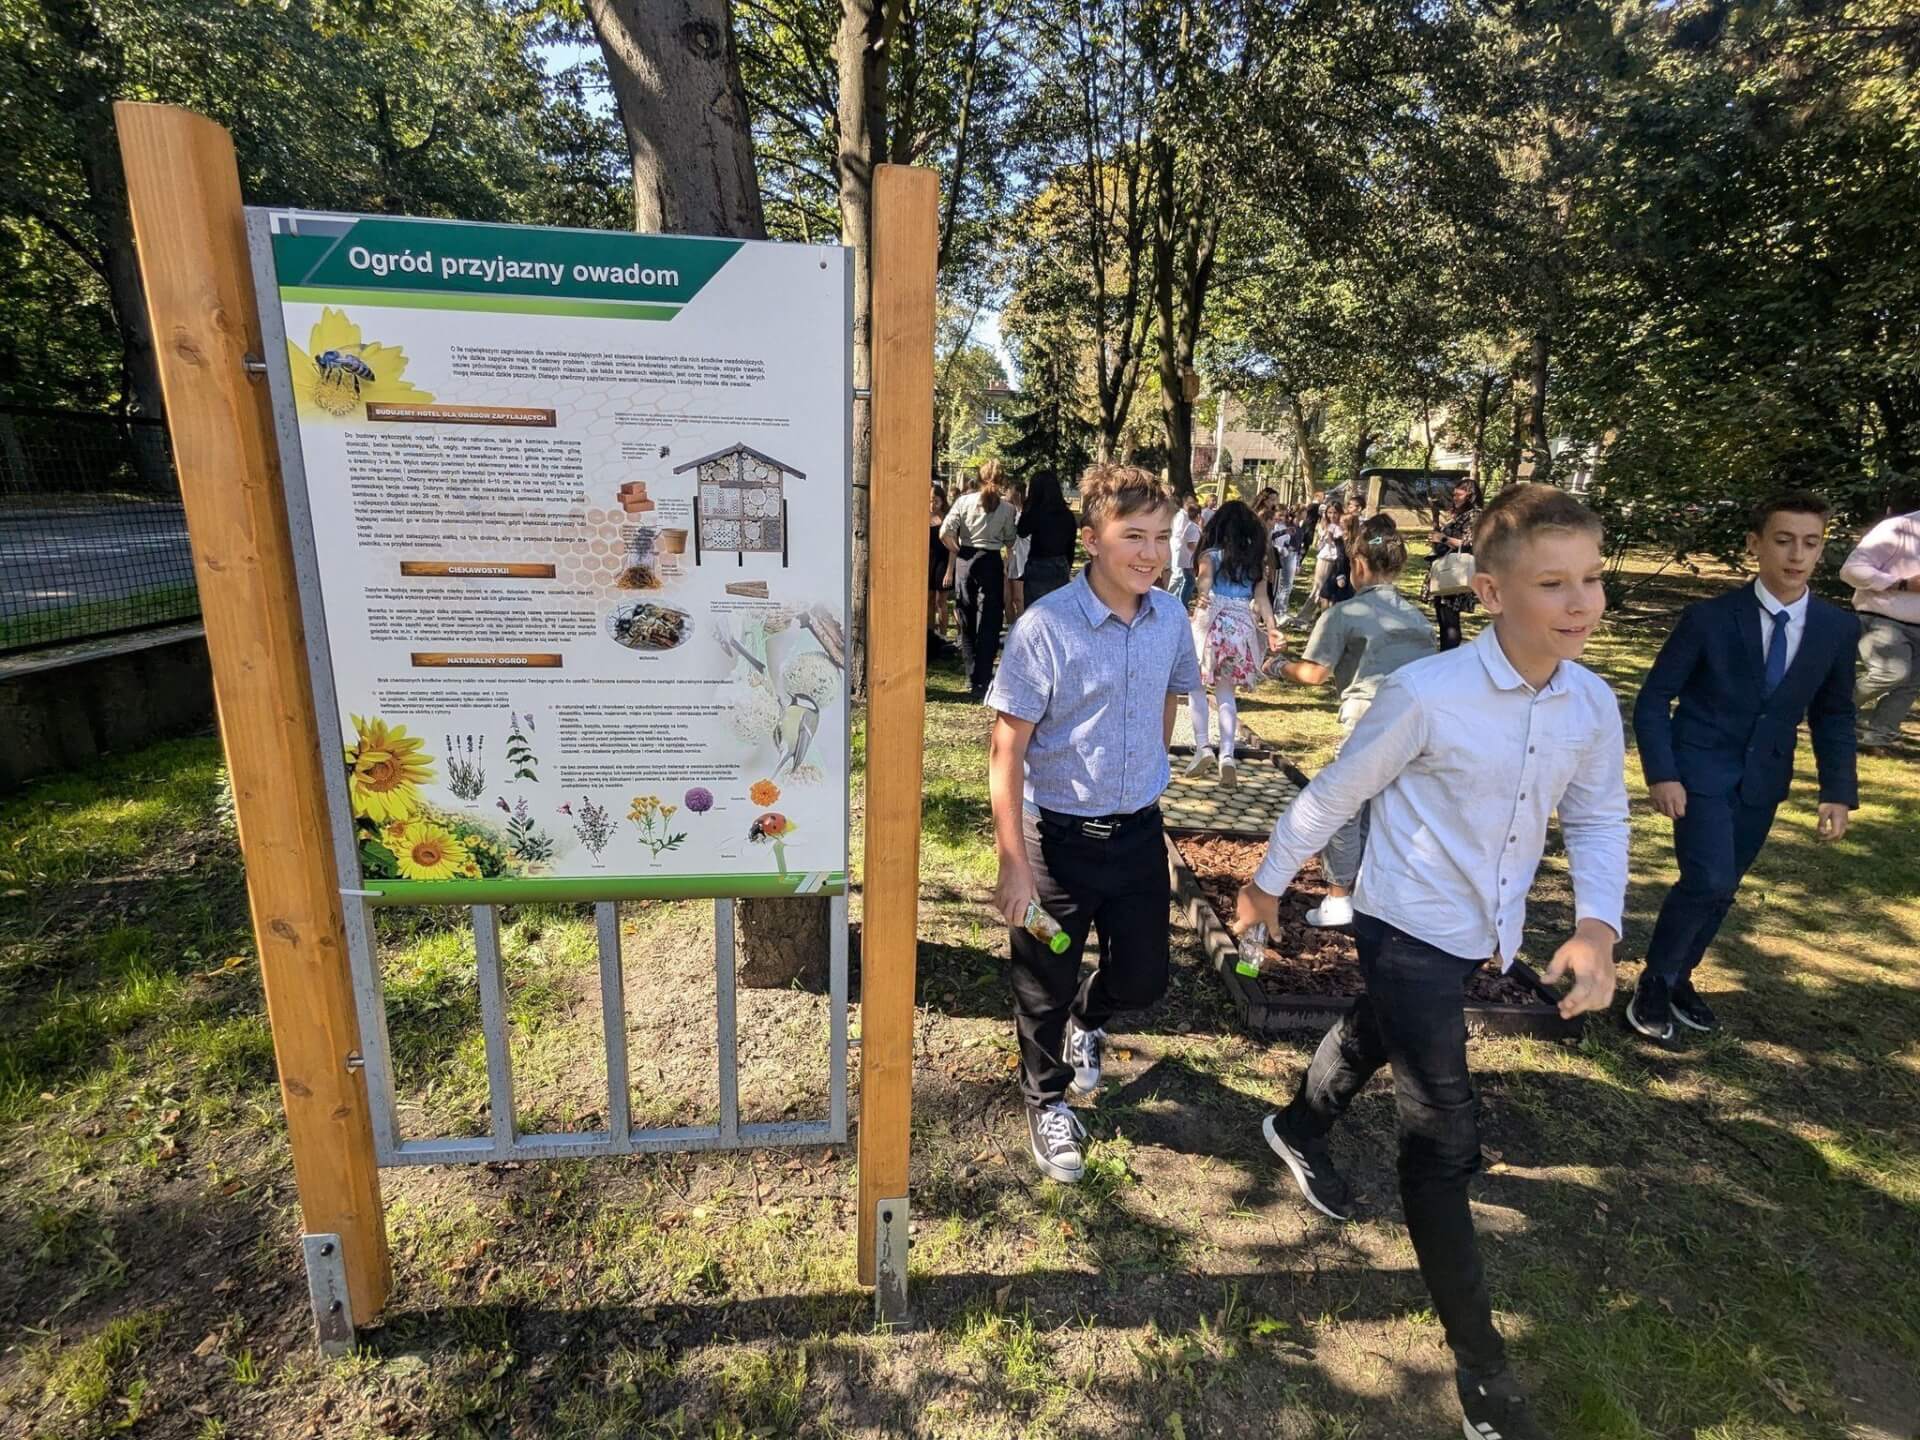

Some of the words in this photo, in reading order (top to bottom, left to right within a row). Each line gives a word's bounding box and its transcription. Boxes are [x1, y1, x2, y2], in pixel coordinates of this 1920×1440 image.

[349, 246, 433, 277] Ogród
[441, 255, 564, 286] przyjazny
[572, 262, 679, 287] owadom
[375, 408, 416, 416] BUDUJEMY
[447, 656, 496, 664] NATURALNY
[498, 655, 528, 664] OGRÓD
